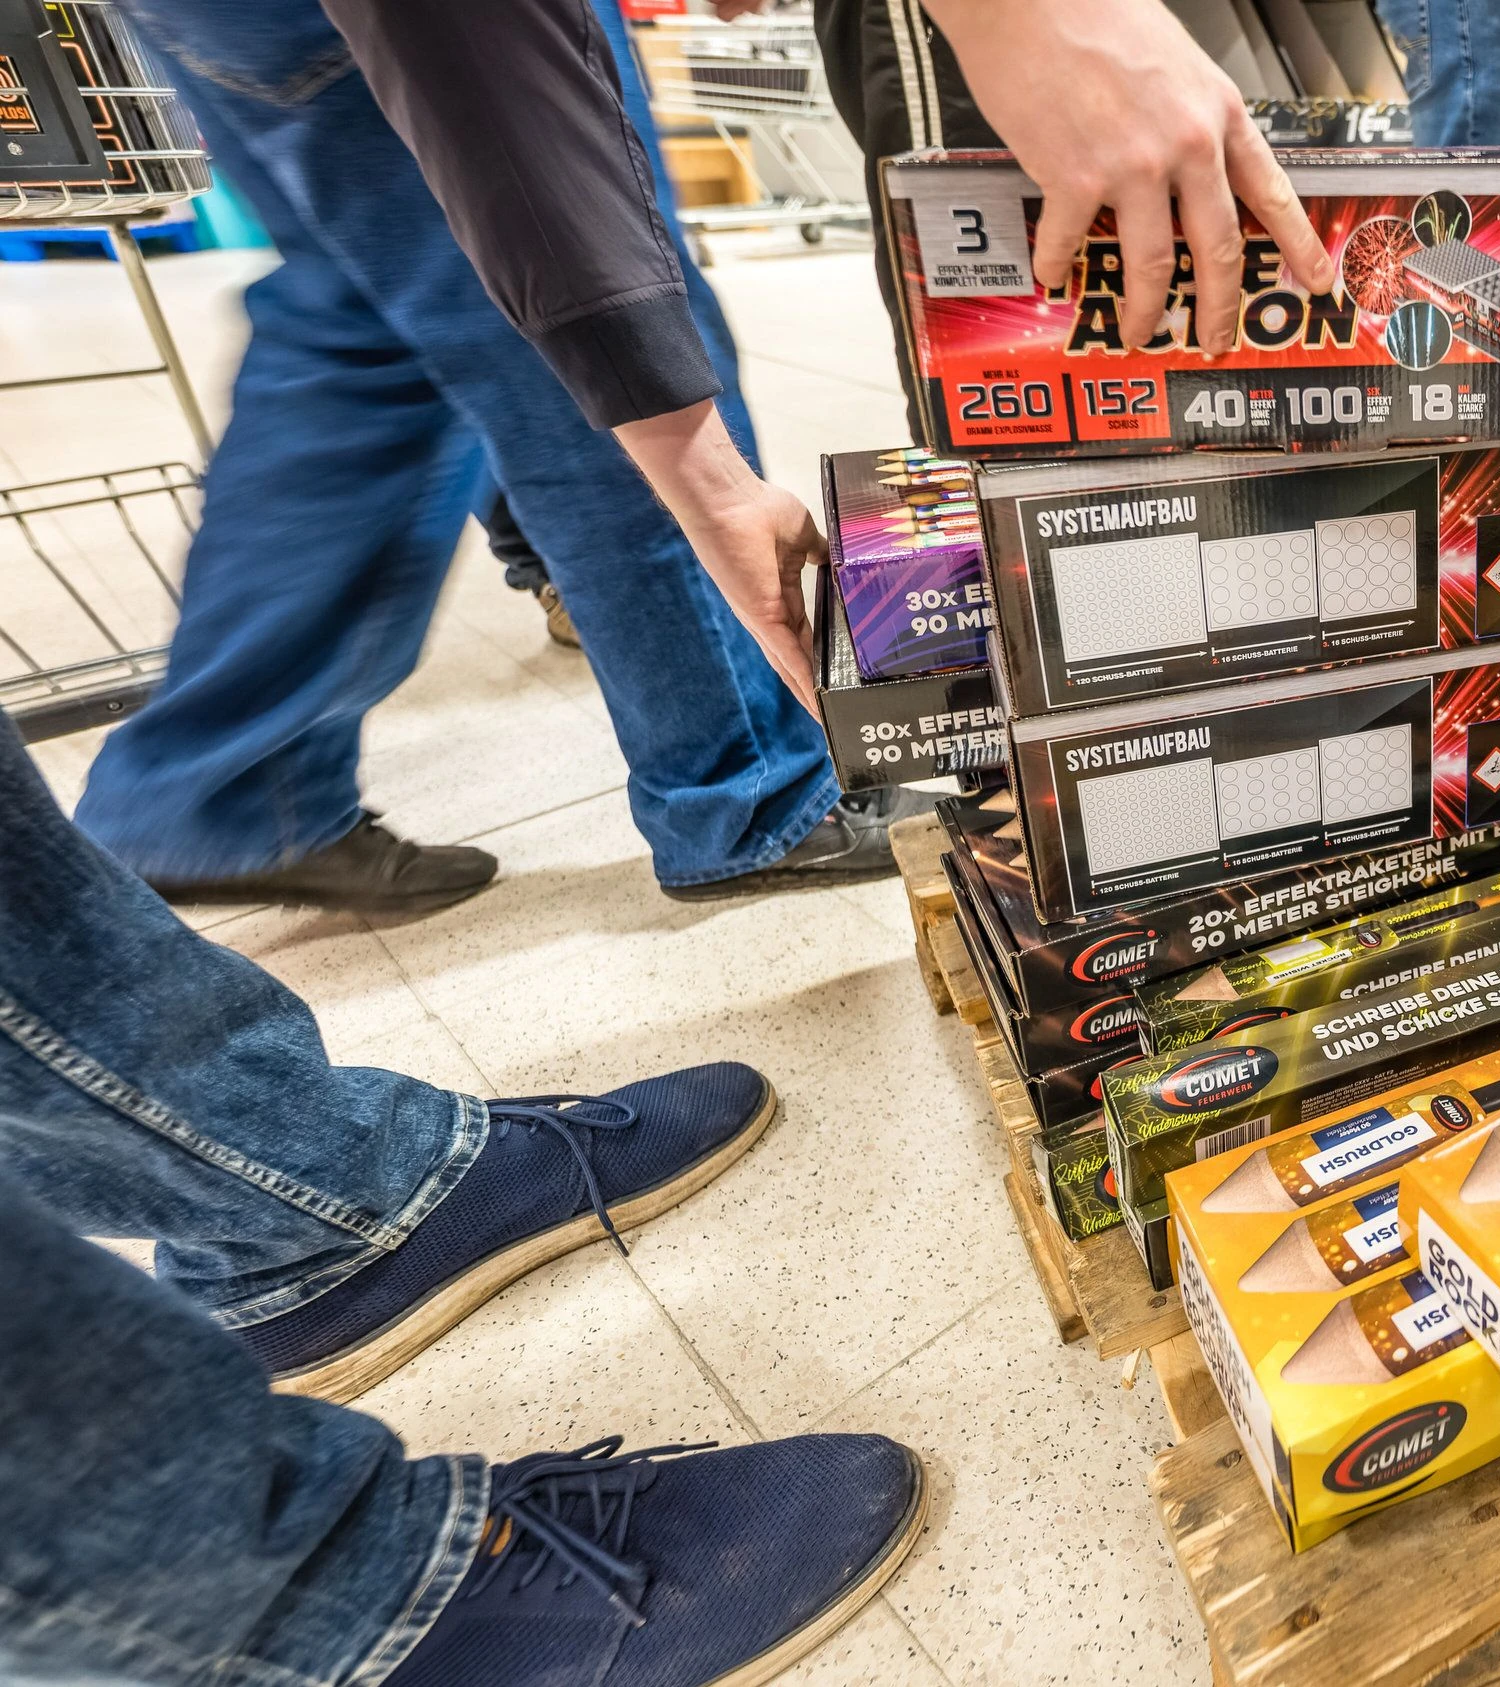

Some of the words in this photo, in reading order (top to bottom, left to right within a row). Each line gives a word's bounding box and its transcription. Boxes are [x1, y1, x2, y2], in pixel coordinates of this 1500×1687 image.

[951, 206, 990, 255] 3
[937, 264, 1018, 276] EFFEKT-BATTERIEN
[934, 276, 978, 287] KOMPLETT
[983, 370, 1003, 379] MEHR
[1005, 369, 1020, 378] ALS
[957, 381, 1054, 421] 260
[1080, 377, 1159, 417] 152
[1250, 389, 1274, 399] METER
[1250, 399, 1277, 410] EFFEKT
[1367, 396, 1393, 406] EFFEKT
[1408, 384, 1453, 422] 18
[1458, 392, 1486, 403] KALIBER
[1184, 390, 1246, 428] 40
[1285, 386, 1362, 425] 100
[1367, 405, 1390, 416] DAUER
[994, 423, 1053, 435] EXPLOSIVMASSE
[1108, 419, 1139, 430] SCHUSS
[1036, 496, 1197, 539] SYSTEMAUFBAU
[905, 590, 958, 611] 30x
[911, 616, 947, 638] 90
[1331, 638, 1340, 647] 16
[1341, 630, 1404, 645] SCHUSS-BATTERIE
[1221, 655, 1231, 664] 16
[1231, 645, 1298, 662] SCHUSS-BATTERIE
[1075, 675, 1091, 686] 120
[1092, 666, 1164, 683] SCHUSS-BATTERIE
[860, 723, 912, 744] 30x
[865, 745, 901, 767] 90
[1066, 727, 1211, 773] SYSTEMAUFBAU
[1341, 826, 1400, 844] SCHUSS-BATTERIE
[1241, 846, 1303, 865] SCHUSS-BATTERIE
[1099, 885, 1113, 894] 120
[1113, 872, 1179, 891] SCHUSS-BATTERIE
[1188, 906, 1237, 934] 20x
[1244, 841, 1443, 916] EFFEKTRAKETEN
[1450, 828, 1488, 852] MIT
[1191, 929, 1224, 953] 90
[1235, 902, 1318, 941] METER
[1326, 855, 1457, 911] STEIGHÖHE
[1092, 939, 1159, 975] COMET
[1310, 951, 1347, 968] ROCKET
[1273, 966, 1305, 982] WISHES
[1311, 986, 1432, 1041] SCHREIBE
[1321, 1032, 1380, 1061] UND
[1384, 997, 1487, 1043] SCHICKE
[1185, 1056, 1261, 1098] COMET
[1197, 1082, 1253, 1107] FEUERWERK
[1439, 1099, 1463, 1123] COMET
[1339, 1125, 1361, 1138] Meter
[1319, 1124, 1419, 1175] GOLDRUSH
[1361, 1416, 1451, 1478] COMET
[1371, 1448, 1433, 1486] FEUERWERK
